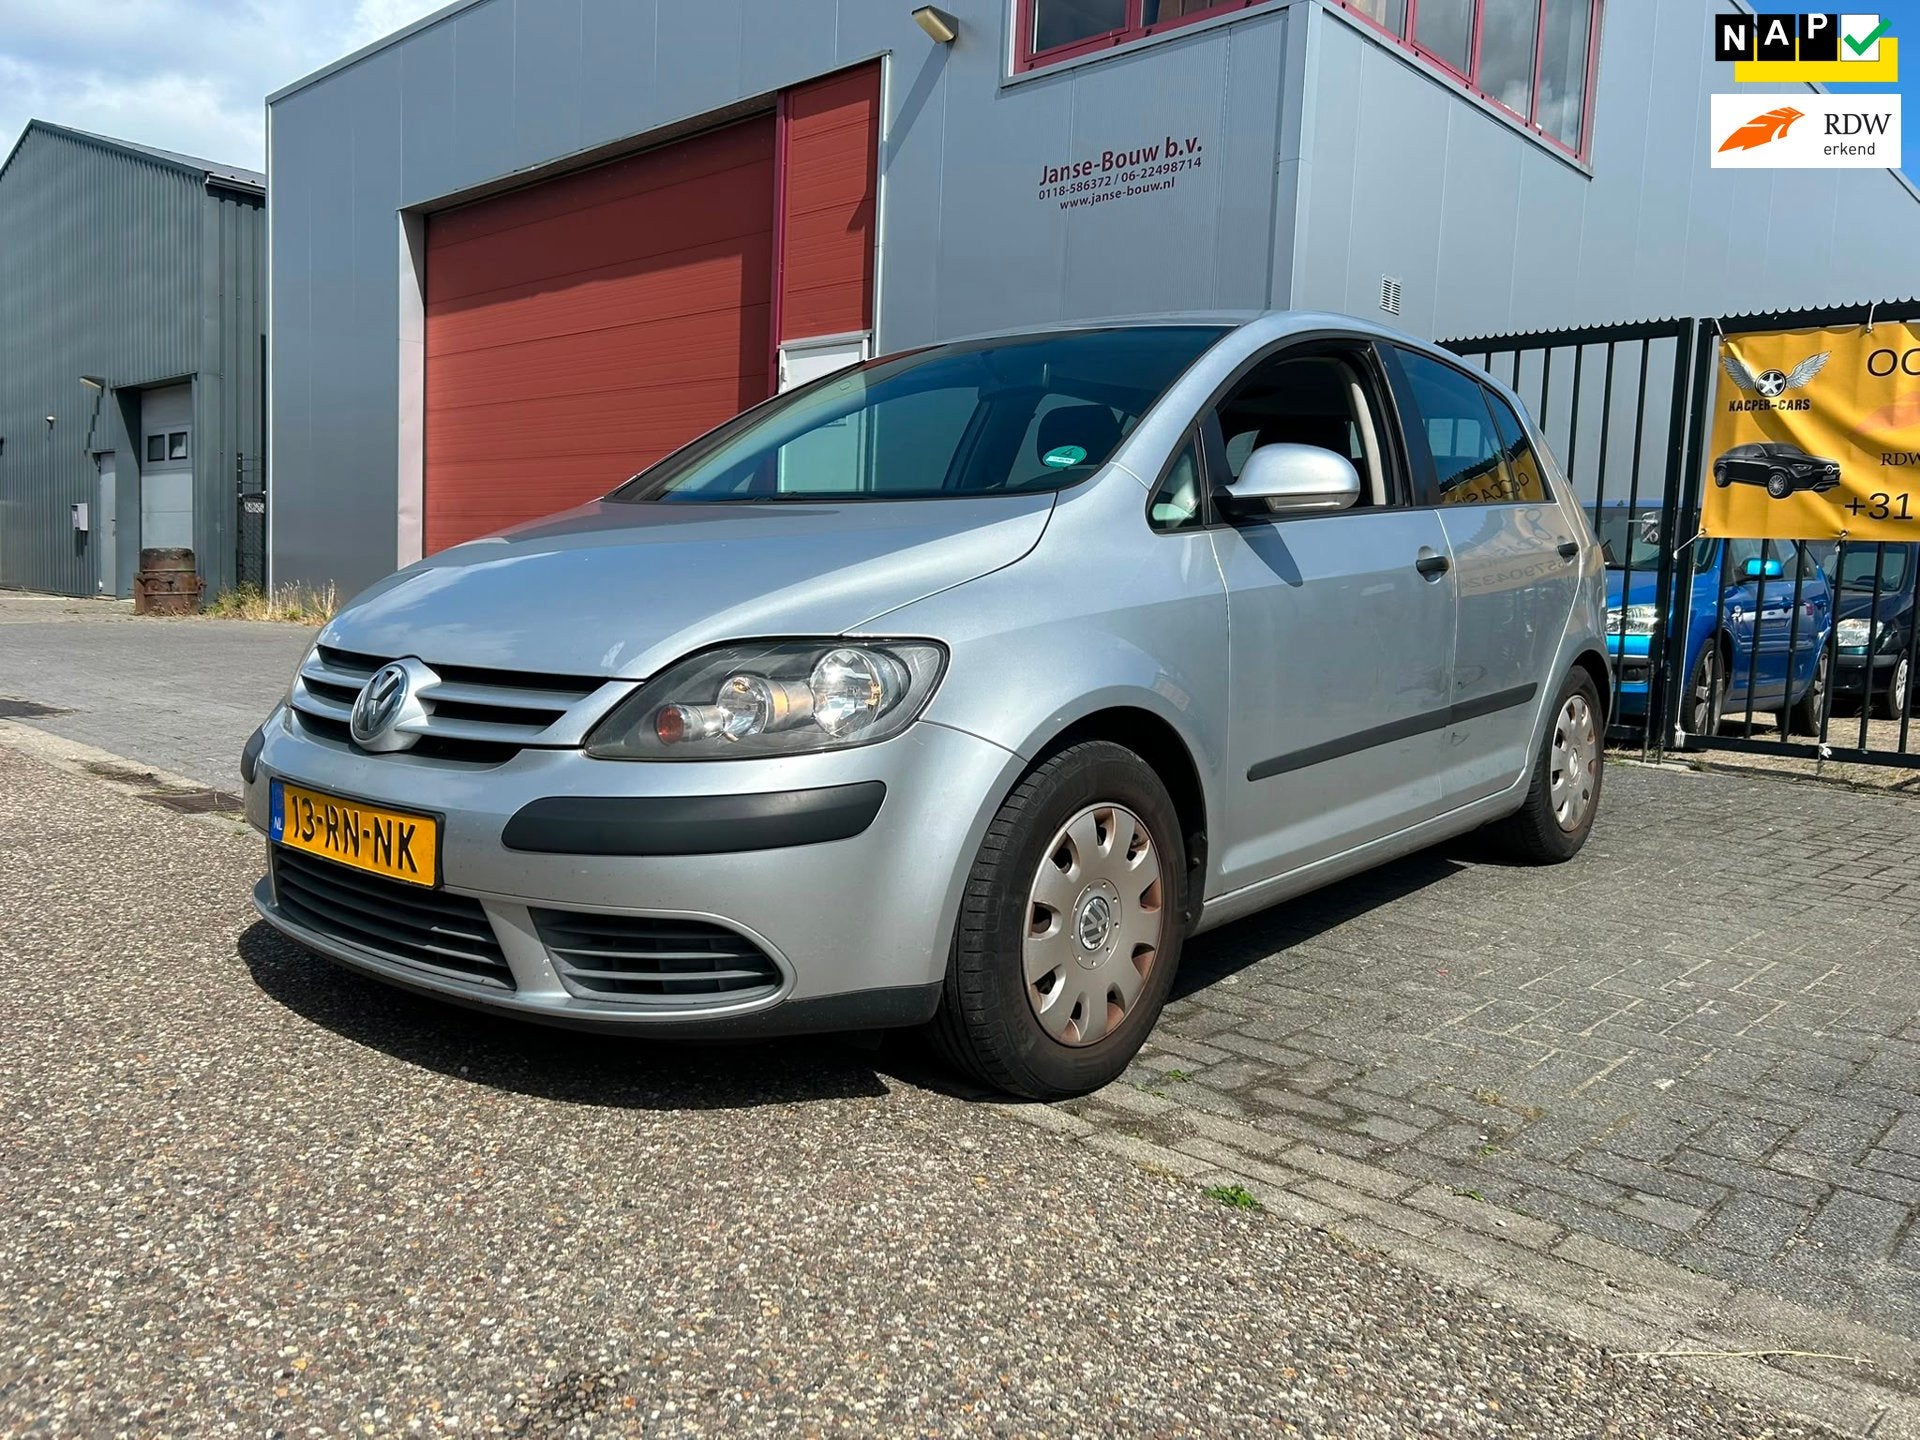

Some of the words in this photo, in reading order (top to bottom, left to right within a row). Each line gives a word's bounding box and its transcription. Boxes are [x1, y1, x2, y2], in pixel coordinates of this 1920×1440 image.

[1039, 145, 1160, 186] Janse-Bouw
[1165, 136, 1203, 159] b.v.
[1038, 175, 1112, 200] 0118-586372
[1121, 157, 1202, 183] 06-22498714
[1059, 176, 1176, 210] www.janse-bouw.nl
[1728, 398, 1811, 412] KACPER-CARS
[1845, 492, 1914, 520] +31
[273, 815, 283, 831] NL
[291, 795, 418, 873] 13-RN-NK
